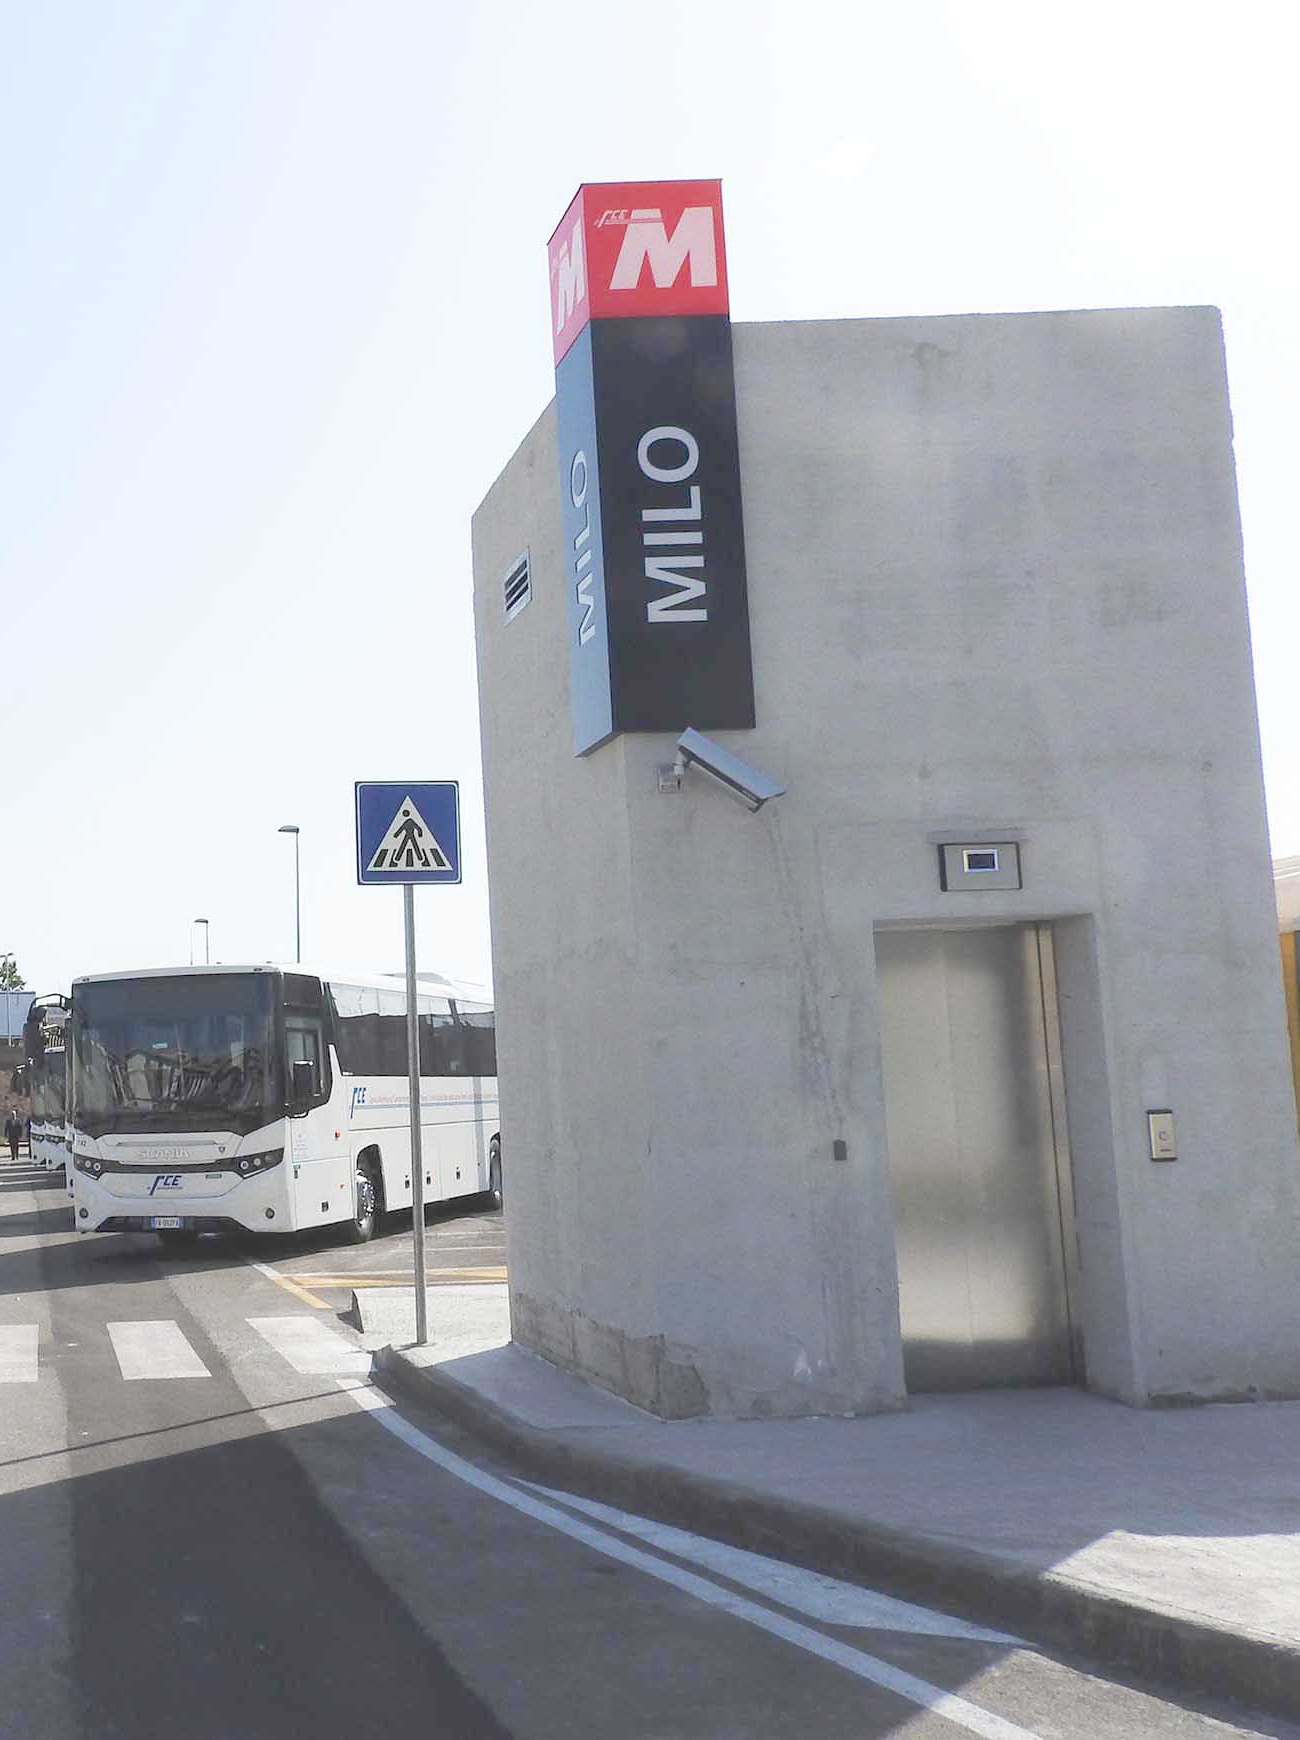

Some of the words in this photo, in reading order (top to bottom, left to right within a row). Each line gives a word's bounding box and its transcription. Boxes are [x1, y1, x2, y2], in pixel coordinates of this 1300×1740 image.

[556, 216, 585, 335] M
[609, 206, 718, 290] M
[571, 450, 596, 647] MILO
[637, 425, 708, 623] MILO
